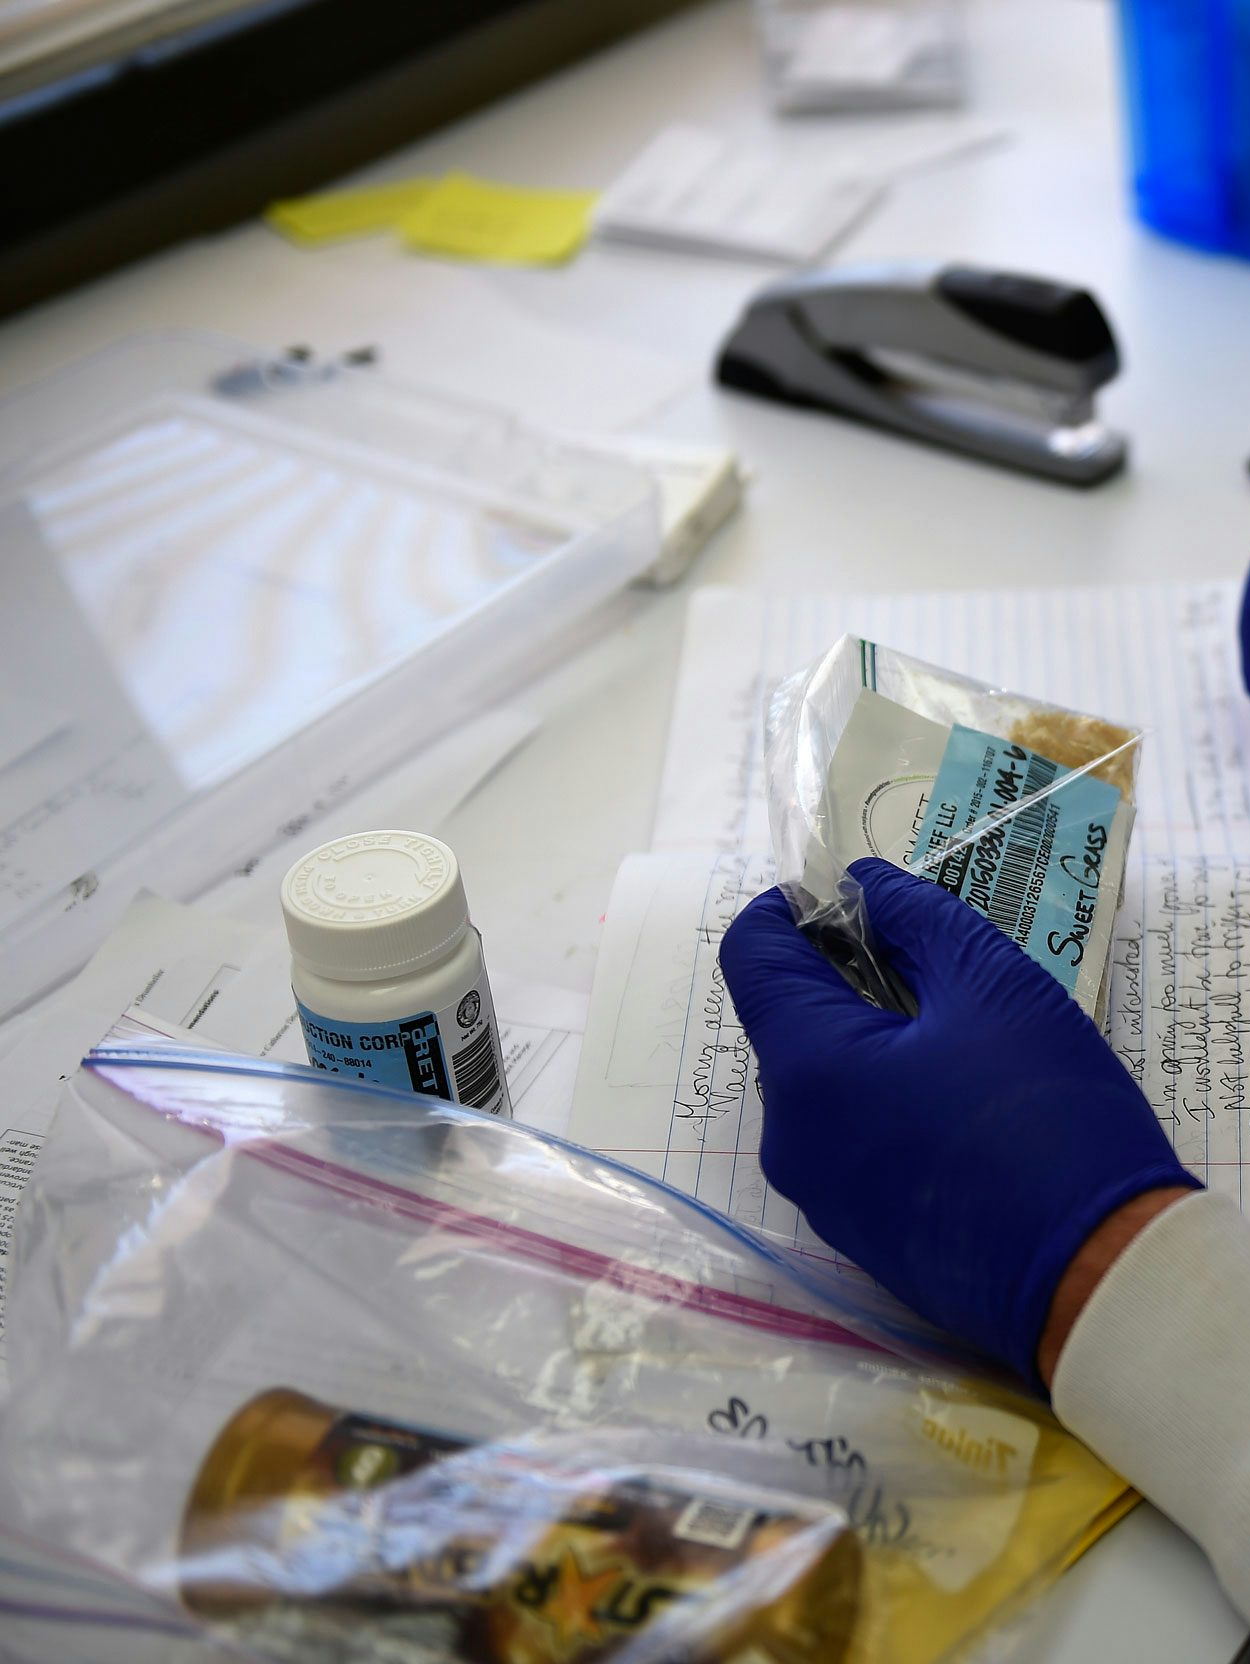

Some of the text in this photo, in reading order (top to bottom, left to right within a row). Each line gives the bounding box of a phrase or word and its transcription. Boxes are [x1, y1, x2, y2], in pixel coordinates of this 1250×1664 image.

[935, 802, 957, 828] LLC
[318, 835, 444, 890] CLOSE TIGHTLY
[324, 876, 392, 904] TO OPEN
[302, 898, 346, 919] DOWN
[374, 895, 423, 917] TURN
[1047, 889, 1097, 967] SWEET
